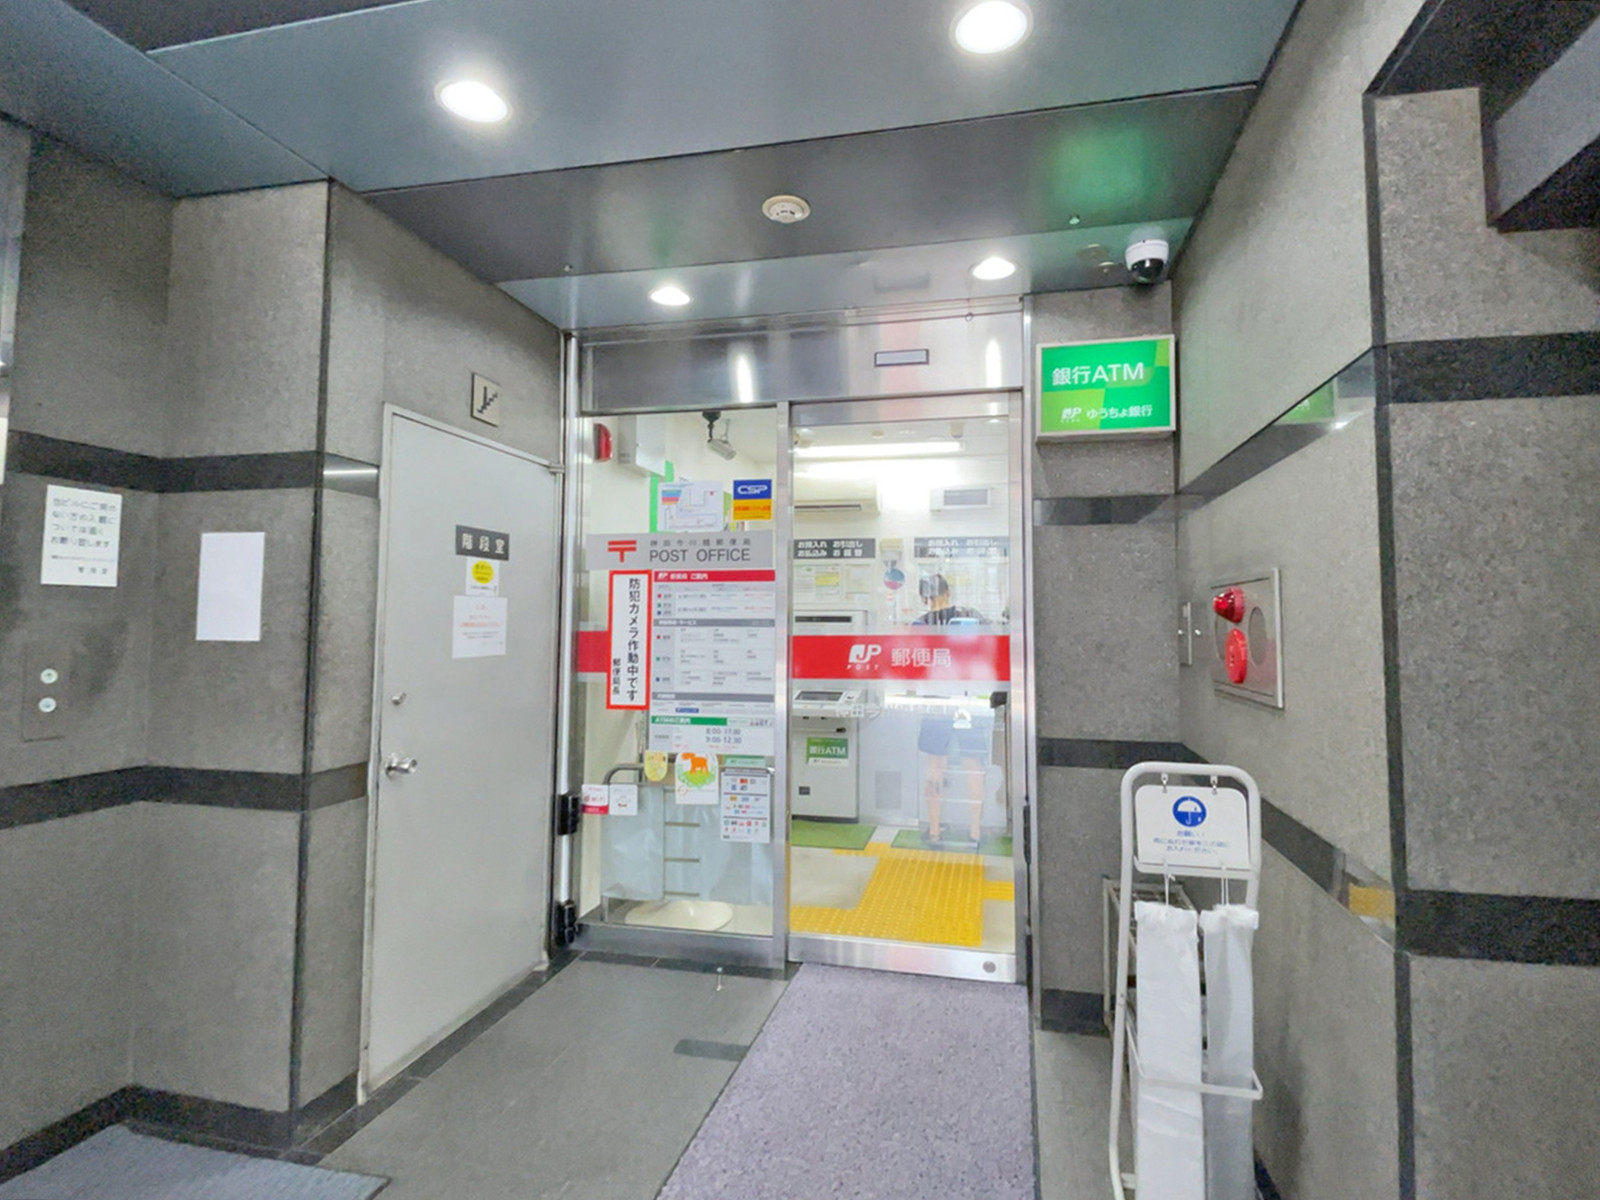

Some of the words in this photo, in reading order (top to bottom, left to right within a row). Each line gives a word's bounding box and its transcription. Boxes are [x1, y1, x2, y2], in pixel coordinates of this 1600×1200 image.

[1052, 362, 1145, 386] 銀行ATM
[1086, 404, 1153, 420] ゆうちょ銀行
[737, 484, 768, 494] CSP
[462, 532, 505, 554] 階段室
[649, 548, 688, 563] POST
[696, 547, 751, 562] OFFICE
[627, 578, 641, 702] 防犯カメラ作動中です
[891, 648, 952, 667] 郵便局
[613, 658, 622, 695] 郵便局長
